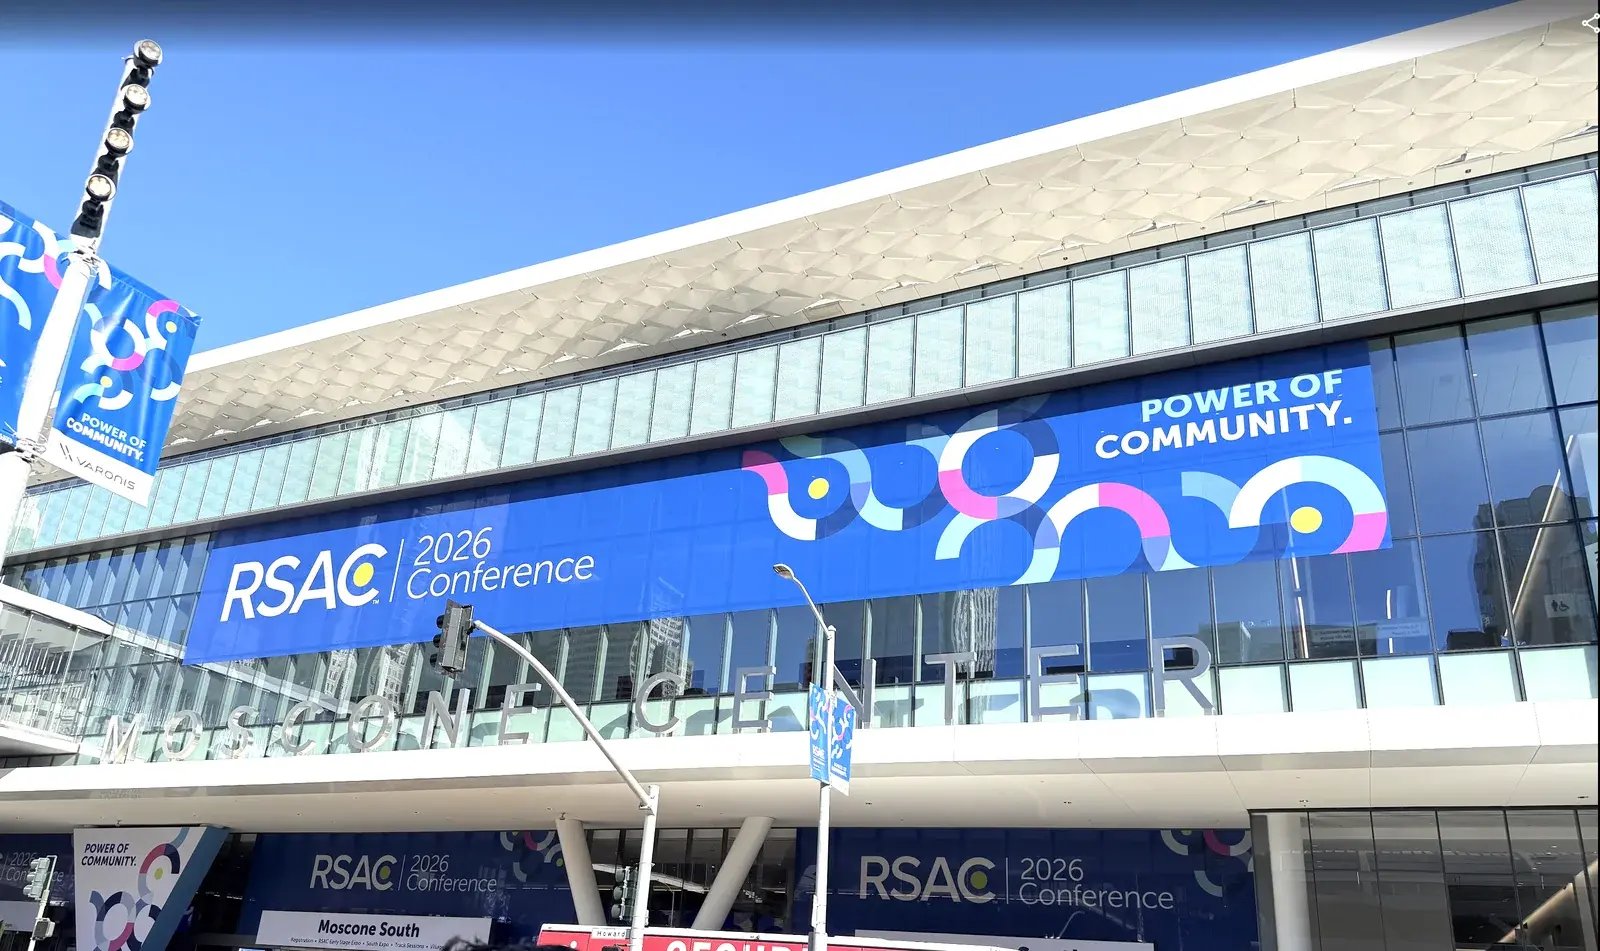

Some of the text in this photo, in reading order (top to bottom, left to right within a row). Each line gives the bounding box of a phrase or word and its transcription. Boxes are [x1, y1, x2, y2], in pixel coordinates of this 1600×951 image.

[1140, 368, 1343, 423] POWER OF
[66, 417, 144, 462] COMMUNITY.
[81, 412, 147, 449] POWER OF
[1095, 400, 1352, 459] COMMUNITY.
[76, 456, 136, 490] VARONIS
[413, 527, 493, 567] 2026
[220, 543, 388, 623] RSAC
[406, 555, 595, 600] Conference
[101, 635, 1216, 764] MOSCONE CENTER
[81, 855, 137, 866] COMMUNITY.
[84, 843, 130, 854] POWER OF
[410, 854, 450, 872] 2026
[309, 854, 398, 891] RSAC
[406, 873, 497, 892] Conference
[859, 855, 996, 904] RSAC
[1020, 857, 1084, 882] 2026
[1018, 882, 1174, 909] Conference
[318, 919, 420, 938] Moscone South
